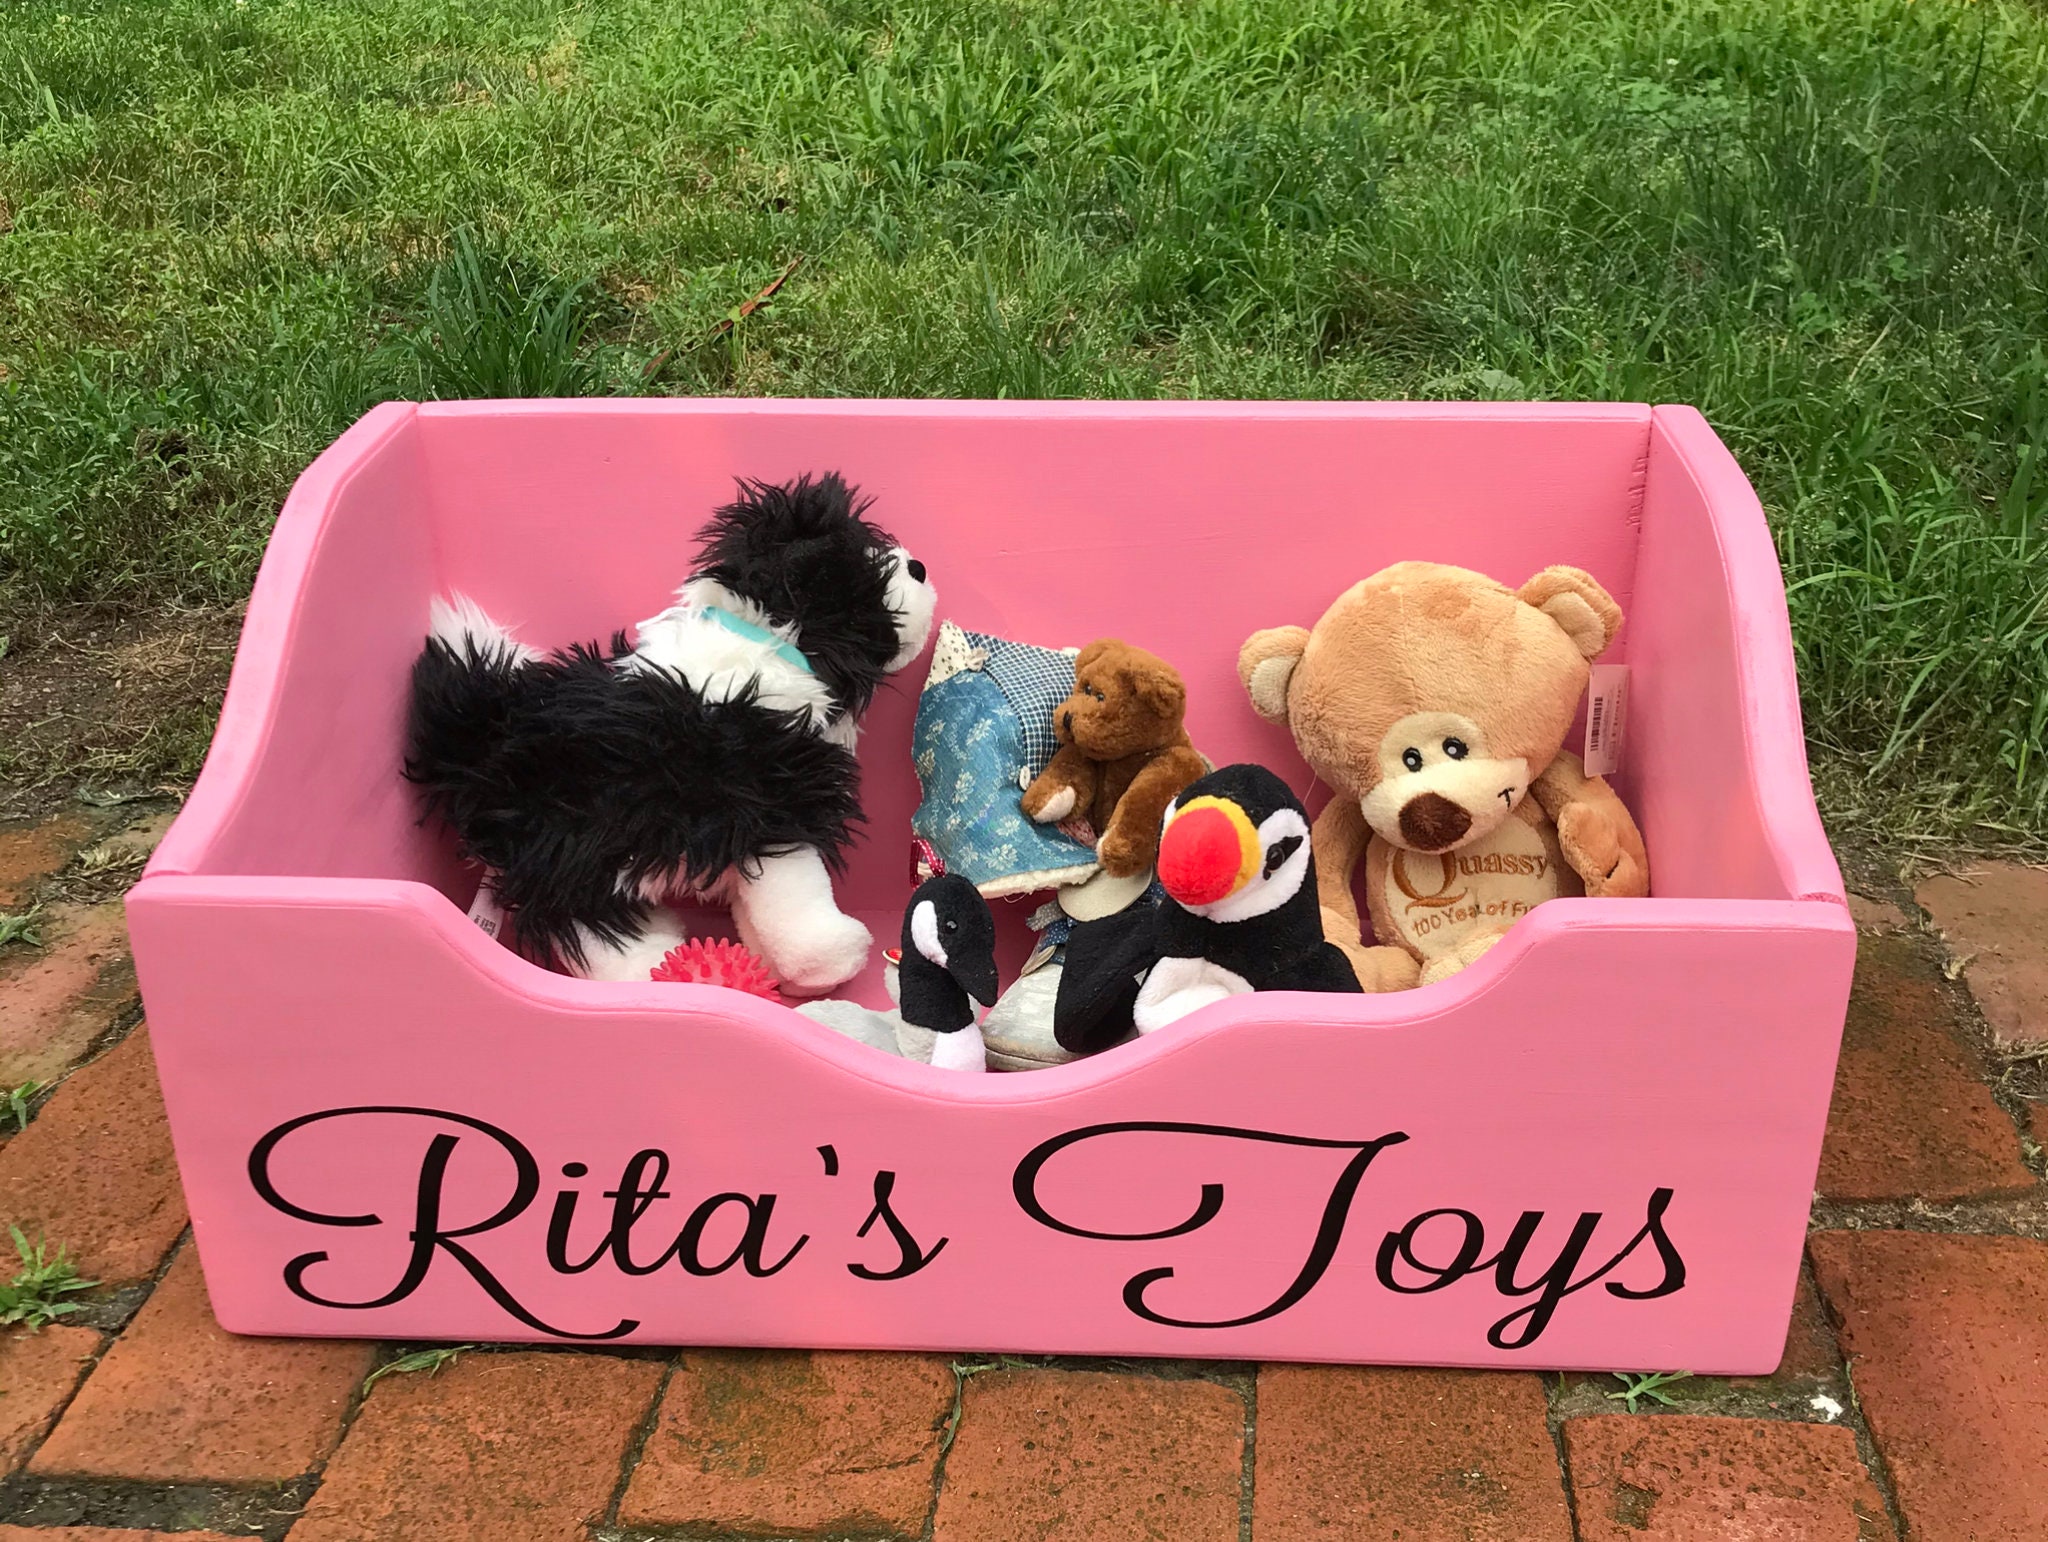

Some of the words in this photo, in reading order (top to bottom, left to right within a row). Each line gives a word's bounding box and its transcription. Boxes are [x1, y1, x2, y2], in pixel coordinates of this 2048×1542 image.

[1392, 849, 1548, 915] Quassy
[1411, 914, 1441, 938] 100
[248, 1106, 949, 1340] Rita's
[1012, 1121, 1686, 1350] Toys
